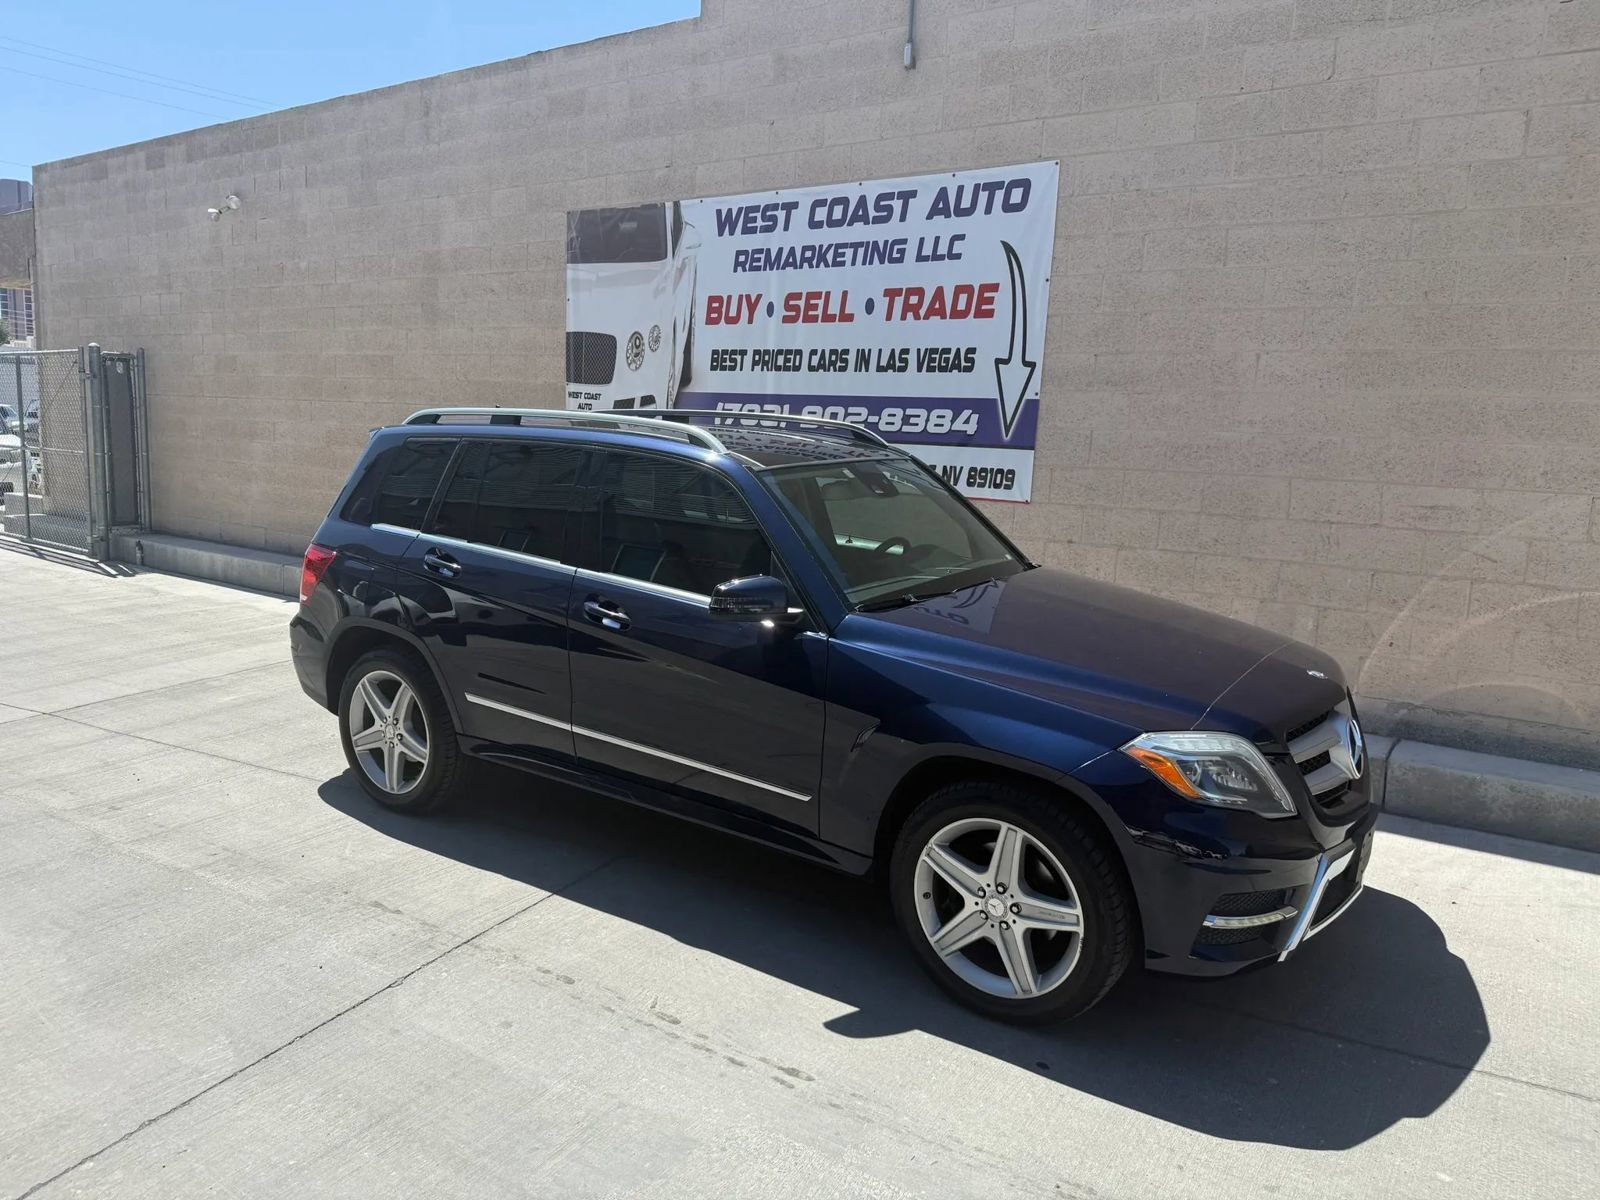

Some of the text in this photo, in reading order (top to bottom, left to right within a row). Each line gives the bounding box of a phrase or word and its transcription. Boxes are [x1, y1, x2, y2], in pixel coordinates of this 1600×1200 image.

[715, 178, 1032, 237] WEST COAST AUTO
[733, 233, 966, 273] REMARKETING LLC
[705, 283, 1000, 325] BUY SELL TRADE
[710, 347, 977, 373] BEST PRICED CARS IN LAS VEGAS
[568, 391, 602, 401] WEST COAST
[577, 402, 593, 411] AUTO
[941, 465, 1016, 490] NV 89109
